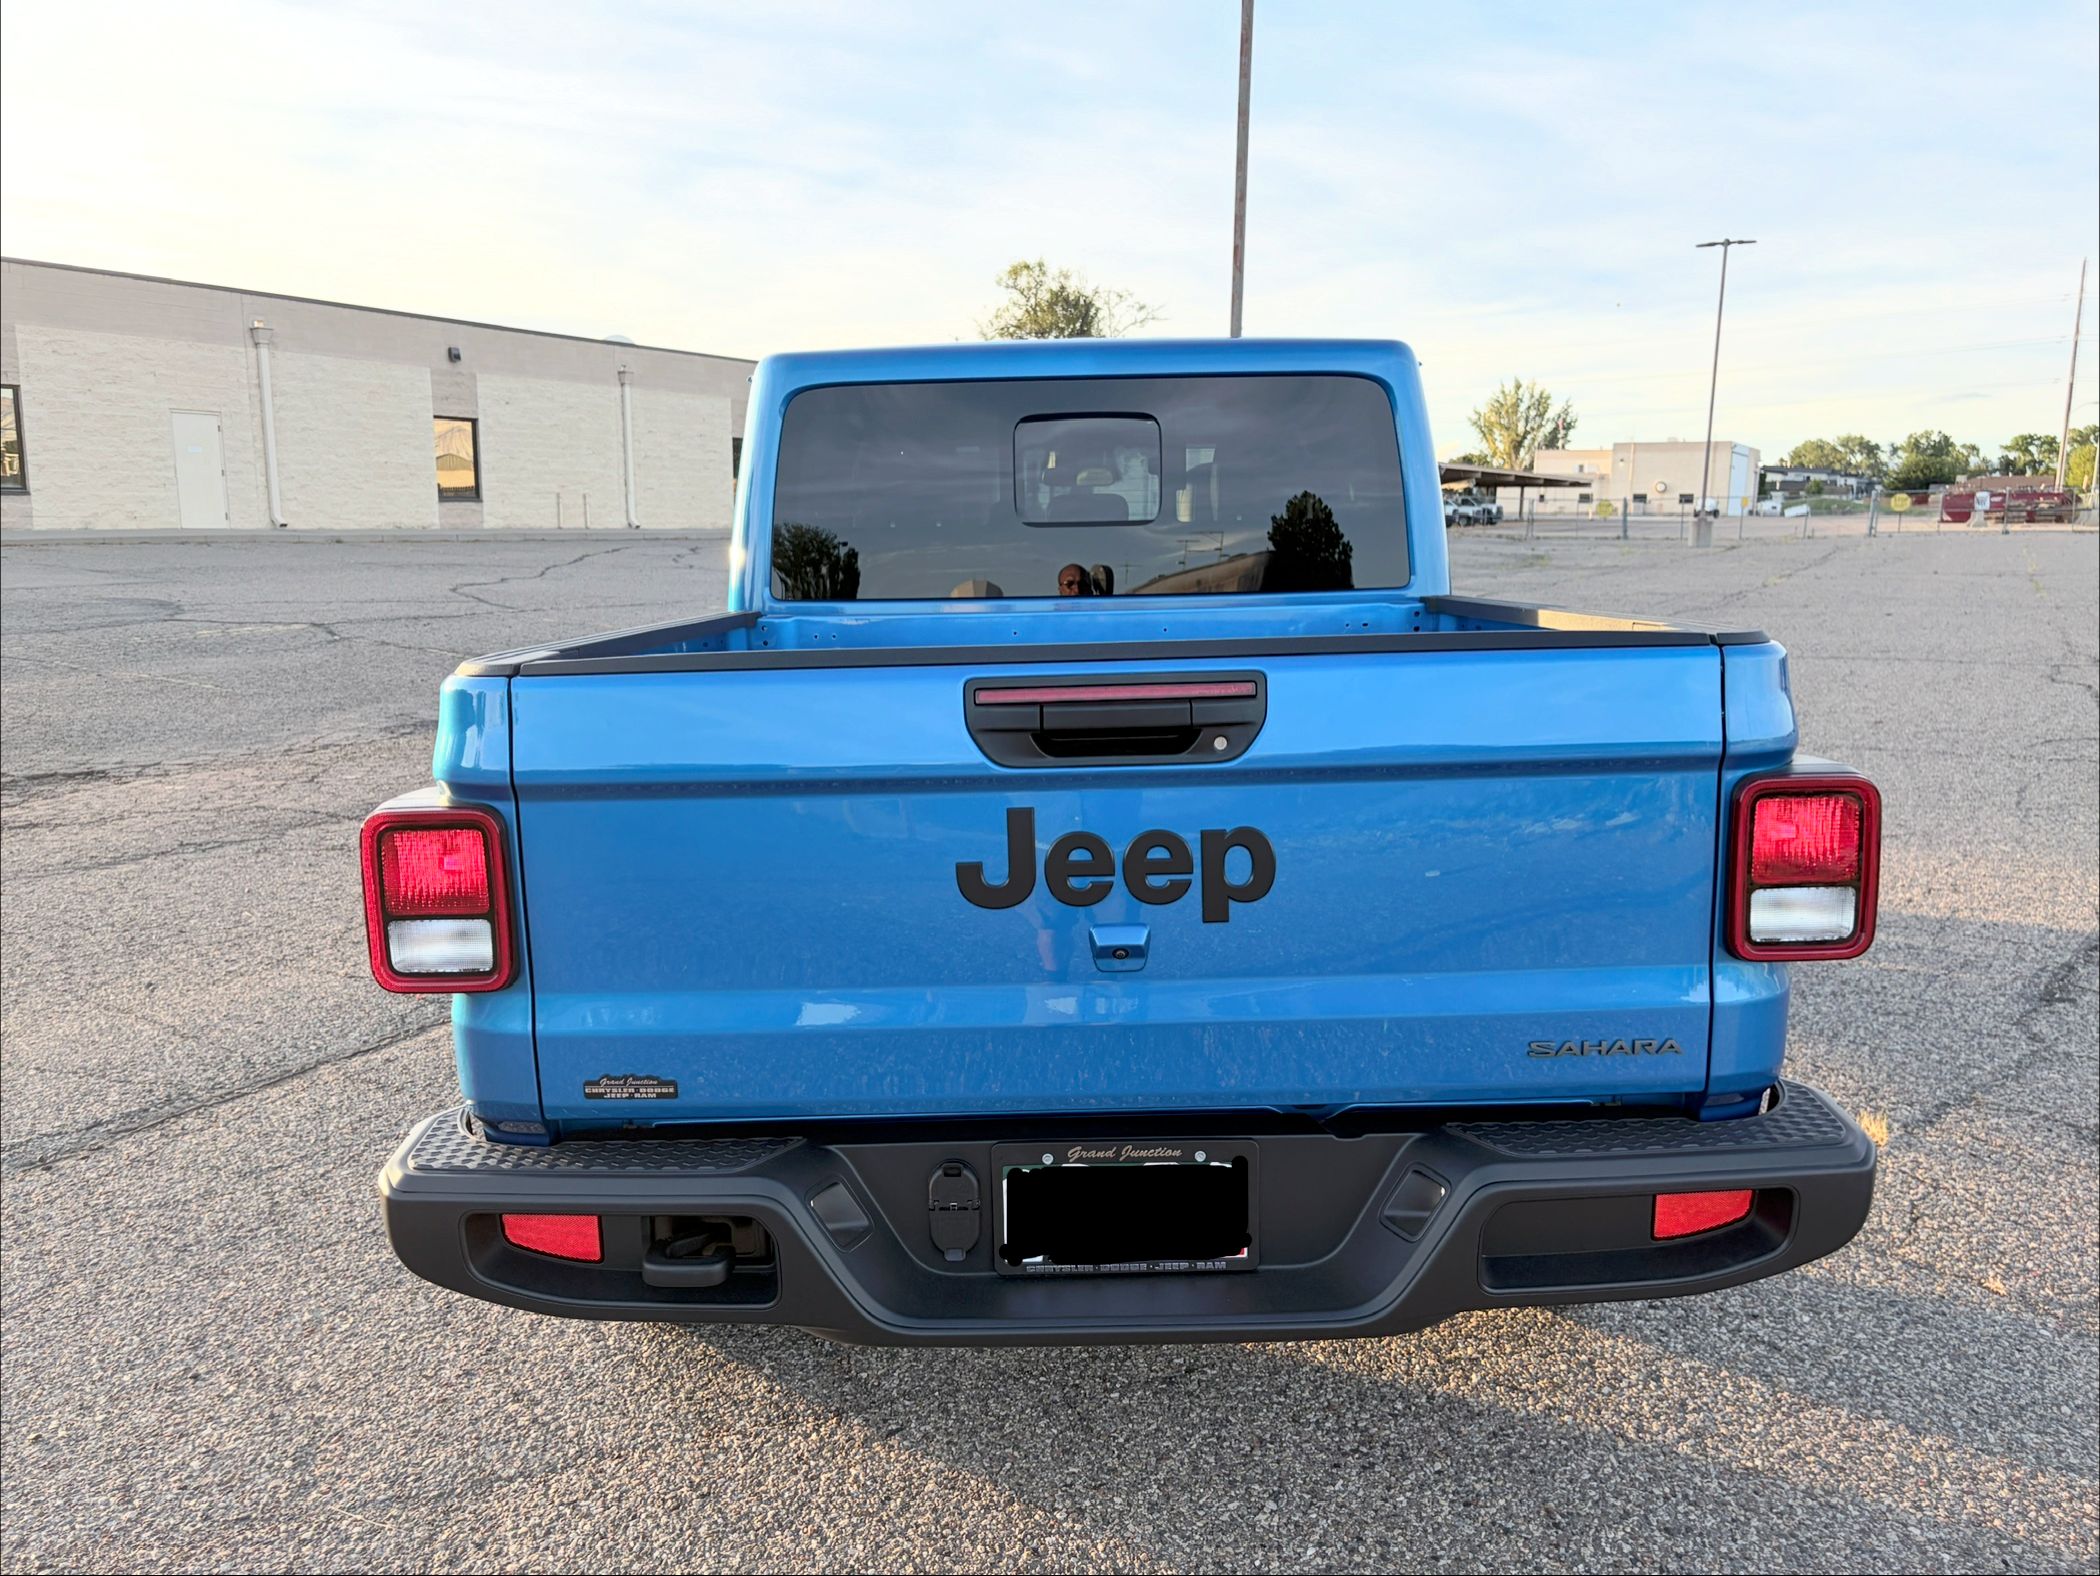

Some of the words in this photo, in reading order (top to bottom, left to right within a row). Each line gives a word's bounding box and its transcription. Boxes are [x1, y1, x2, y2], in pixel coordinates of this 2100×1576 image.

[955, 806, 1277, 923] Jeep
[1527, 1037, 1683, 1057] SAHARA
[600, 1077, 625, 1087] Grand
[626, 1077, 658, 1087] Junction
[1067, 1146, 1117, 1162] Grand
[1119, 1145, 1182, 1161] Junction
[1026, 1264, 1094, 1272] CHRYSLER
[1100, 1263, 1147, 1271] DODGE
[1155, 1262, 1189, 1270] JEEP
[1197, 1261, 1227, 1269] RAM
